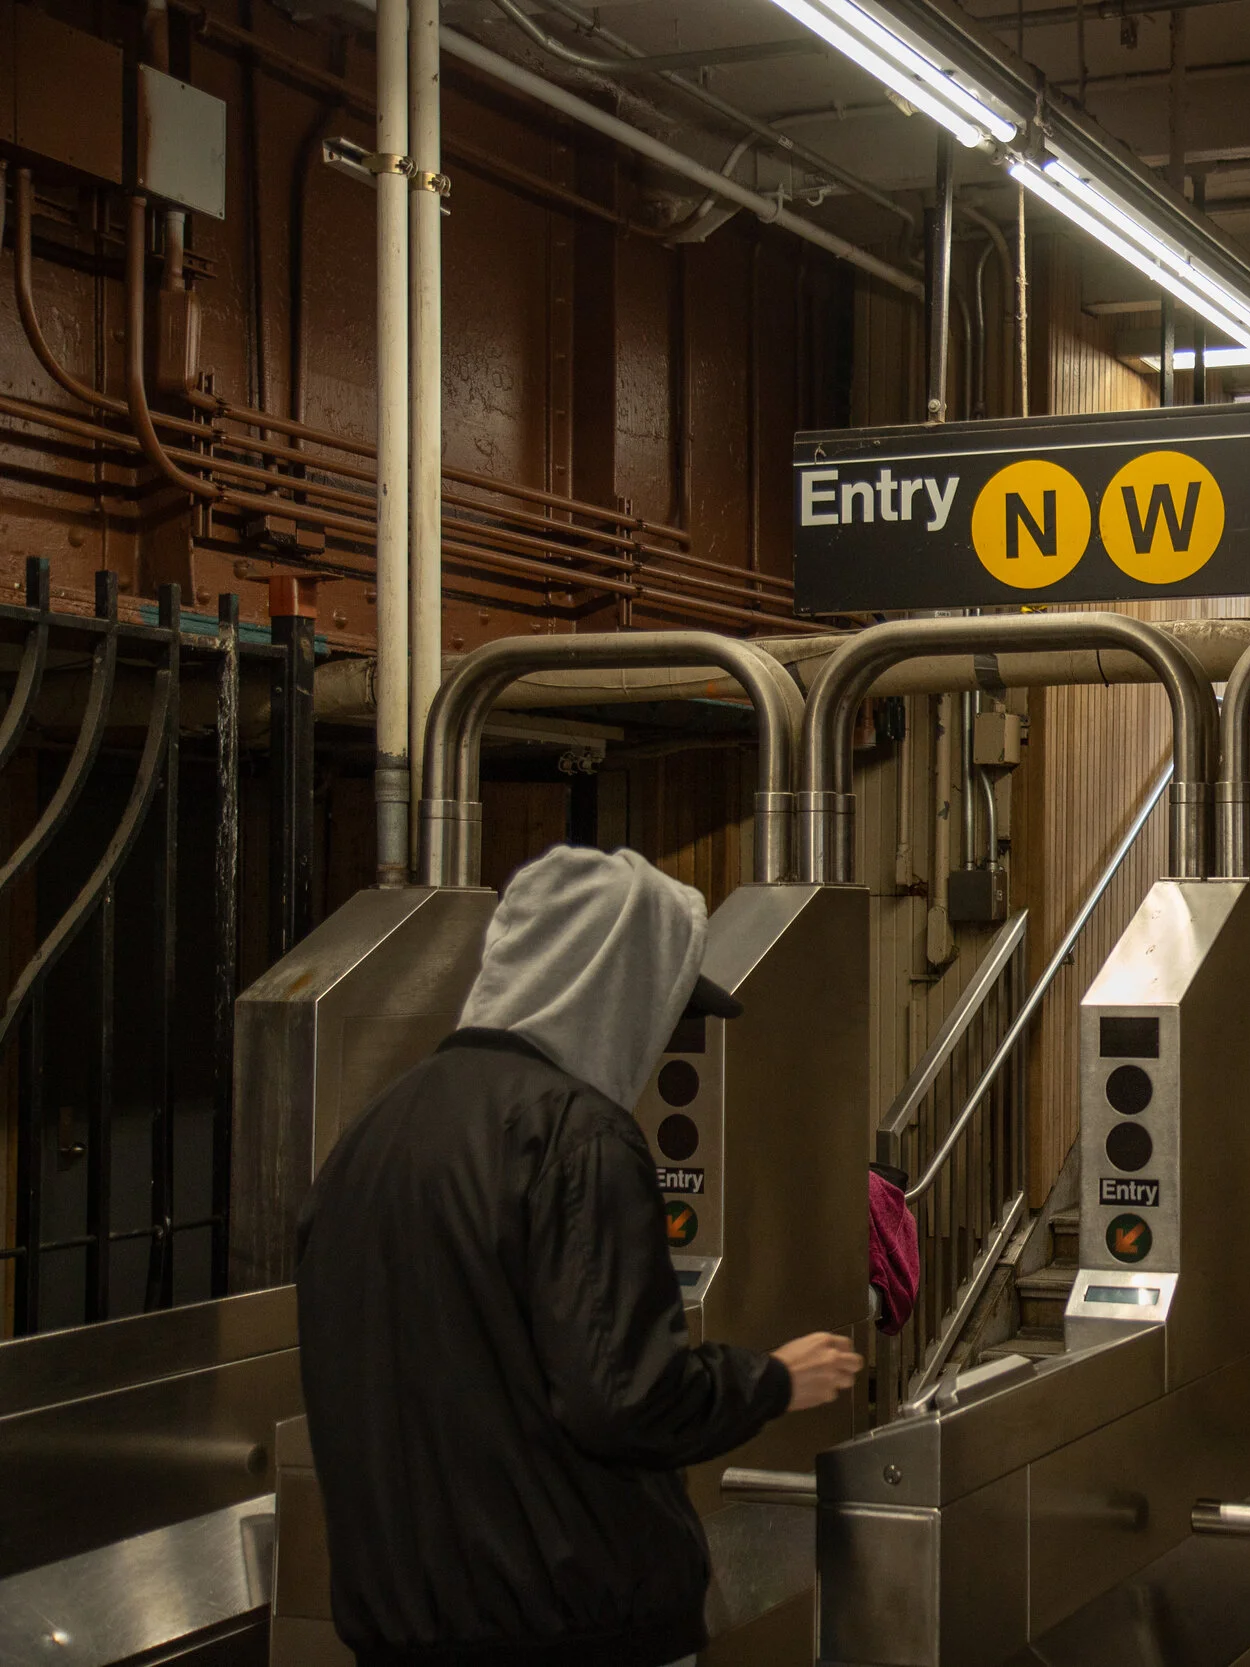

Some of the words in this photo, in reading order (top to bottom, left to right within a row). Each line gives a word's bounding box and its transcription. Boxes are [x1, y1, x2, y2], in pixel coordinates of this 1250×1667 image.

[800, 469, 960, 532] Entry
[1005, 490, 1057, 559] N
[1121, 481, 1202, 554] W
[656, 1168, 704, 1193] Entry
[1102, 1180, 1158, 1206] Entry
